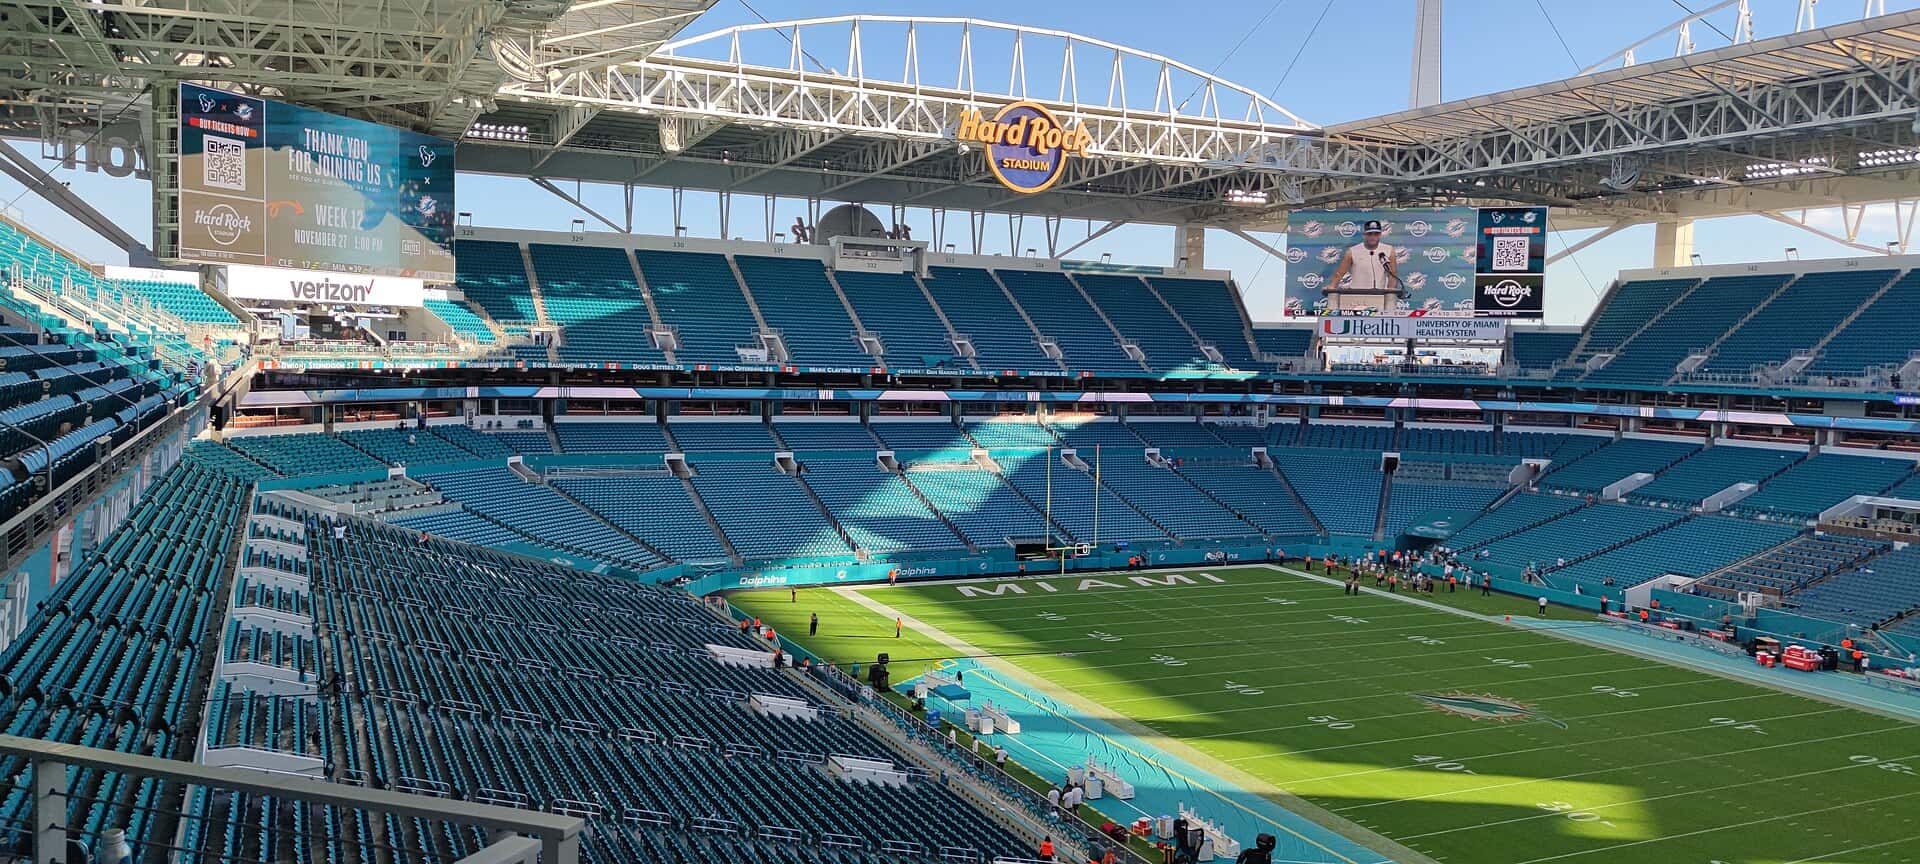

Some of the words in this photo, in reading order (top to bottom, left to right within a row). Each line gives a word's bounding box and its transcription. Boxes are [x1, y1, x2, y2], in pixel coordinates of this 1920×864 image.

[958, 109, 1028, 145] Hard
[1028, 116, 1091, 159] Rock
[304, 127, 343, 157] THANK
[347, 136, 368, 161] YOU
[288, 148, 312, 174] FOR
[315, 154, 363, 182] JOINING
[367, 162, 381, 185] US
[1002, 157, 1050, 171] STADIUM
[194, 209, 224, 226] Hard
[224, 213, 251, 232] Rock
[315, 203, 348, 229] WEEK
[351, 209, 364, 231] 12
[294, 228, 337, 248] NOVEMBER
[354, 236, 370, 251] 1:00
[372, 237, 383, 252] PM
[278, 257, 293, 267] CLE
[332, 263, 346, 272] MIA
[290, 277, 366, 301] verizon
[1483, 285, 1508, 296] Hard
[1508, 285, 1532, 297] Rock
[1313, 309, 1322, 317] 17
[1341, 309, 1354, 317] MIA
[1415, 320, 1460, 329] UNIVERSITY
[1462, 320, 1471, 329] OF
[1473, 320, 1500, 329] MIAMI
[1415, 328, 1445, 337] HEALTH
[1446, 328, 1476, 337] SYSTEM
[818, 389, 834, 400] WIN
[894, 566, 937, 577] Dolphins
[739, 575, 787, 585] Dolphins
[956, 573, 1225, 597] MIAMI
[1307, 715, 1355, 729] 50
[1411, 754, 1465, 771] 40
[1536, 800, 1601, 822] 30
